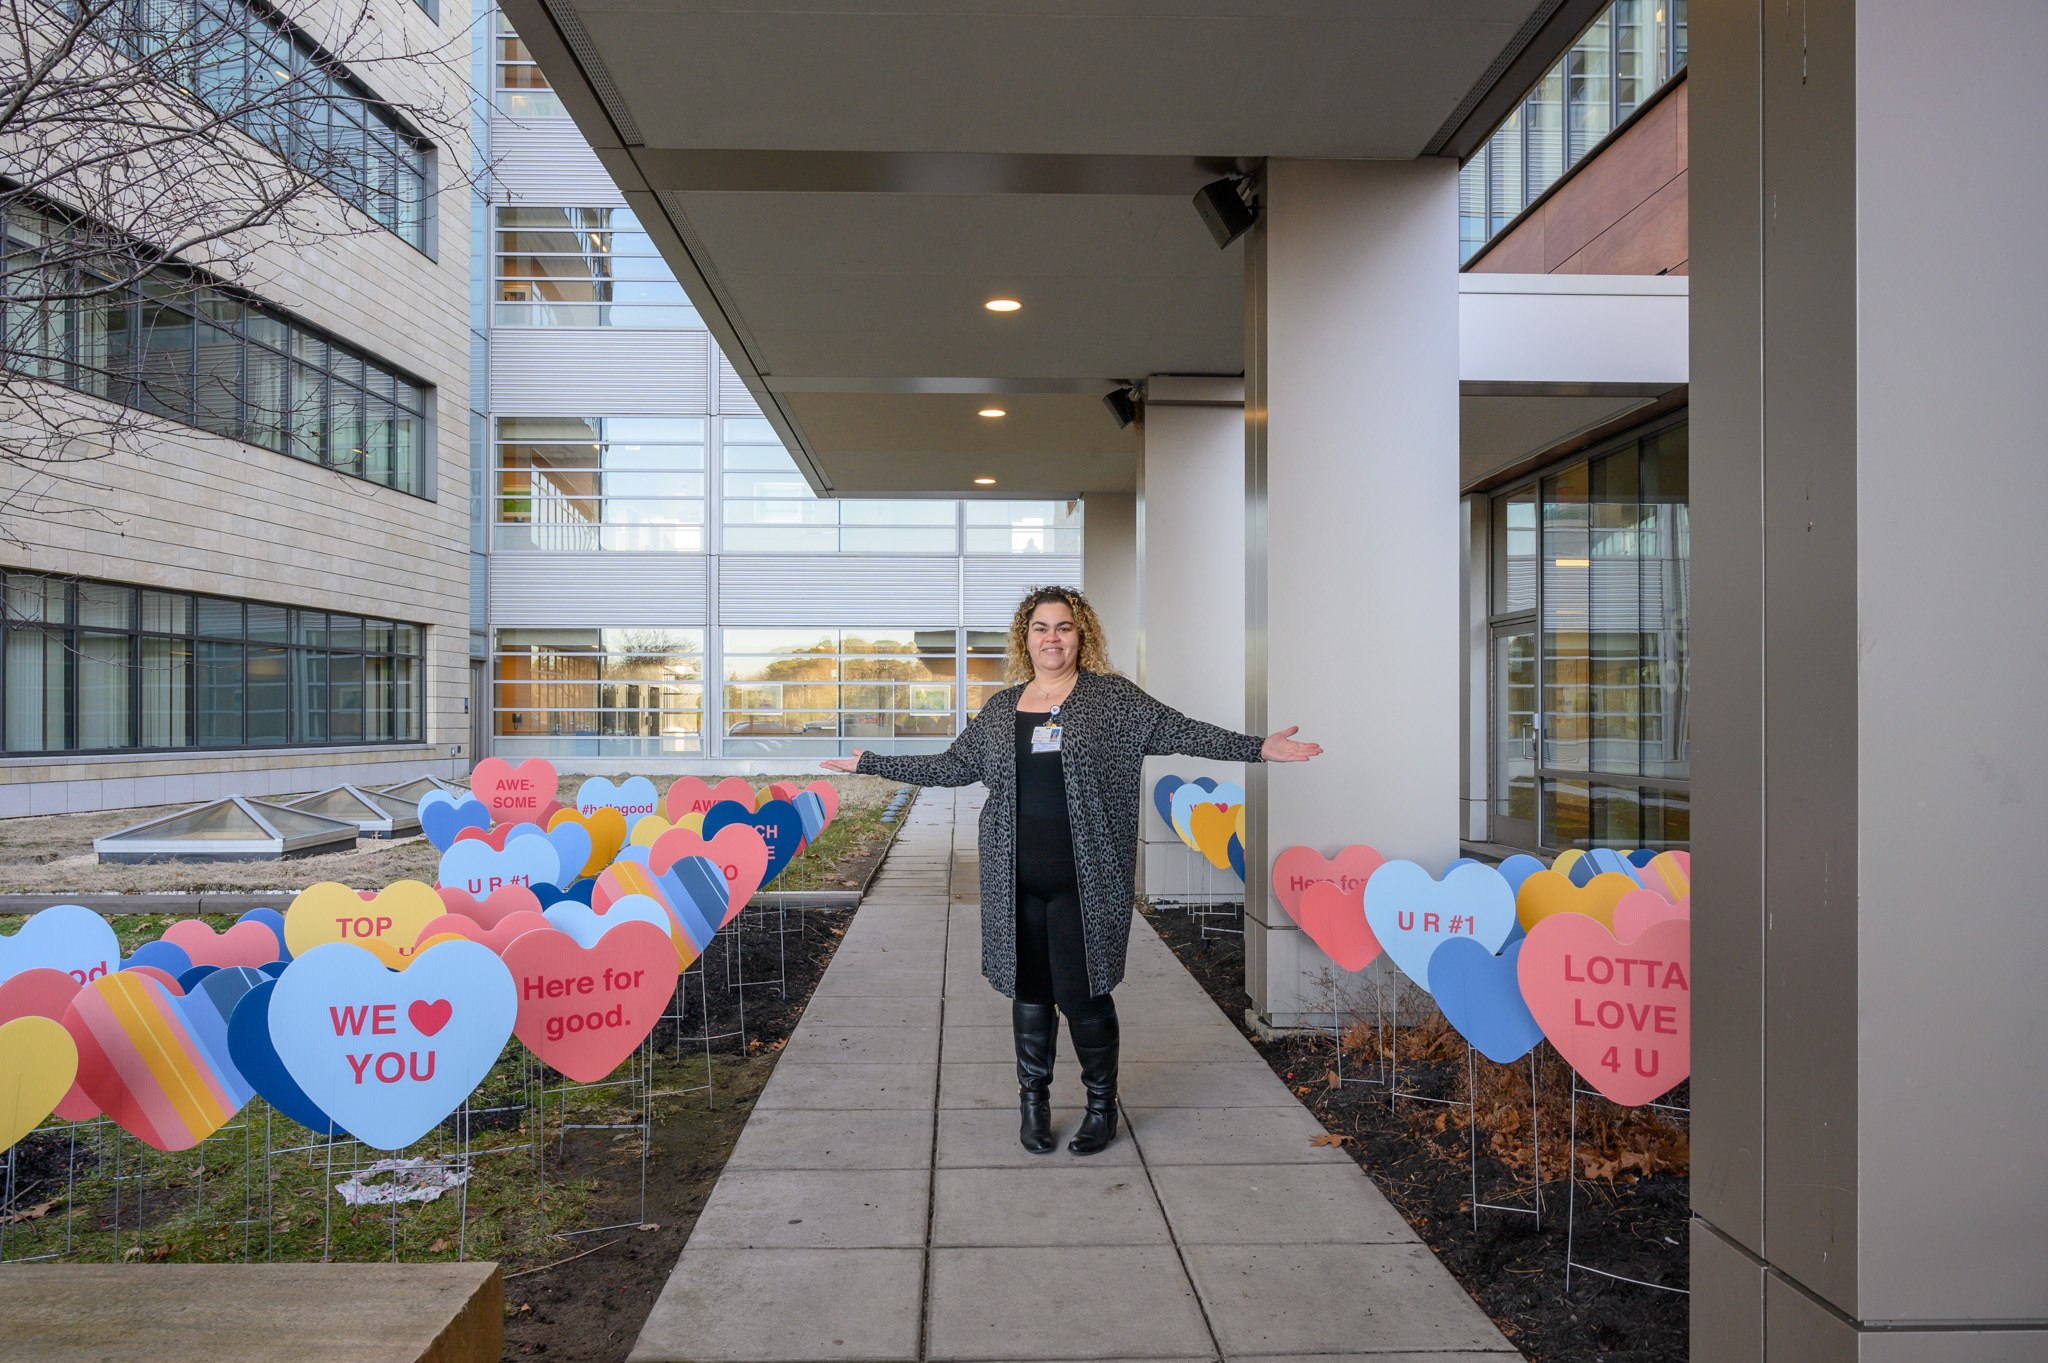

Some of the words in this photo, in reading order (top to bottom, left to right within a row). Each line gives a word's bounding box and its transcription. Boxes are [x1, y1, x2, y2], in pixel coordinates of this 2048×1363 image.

[495, 779, 535, 791] AWE-
[492, 796, 537, 809] SOME
[467, 878, 482, 894] U
[489, 876, 502, 892] R
[509, 874, 529, 889] #1
[335, 916, 393, 938] TOP
[1398, 910, 1414, 931] U
[1423, 912, 1440, 933] R
[1448, 914, 1474, 935] #1
[523, 975, 595, 1001] Here
[602, 967, 645, 991] for
[1564, 954, 1689, 991] LOTTA
[328, 1004, 397, 1036] WE
[546, 1003, 631, 1042] good.
[1574, 998, 1678, 1035] LOVE
[345, 1050, 436, 1085] YOU
[1600, 1046, 1621, 1074] 4
[1634, 1048, 1659, 1078] U
